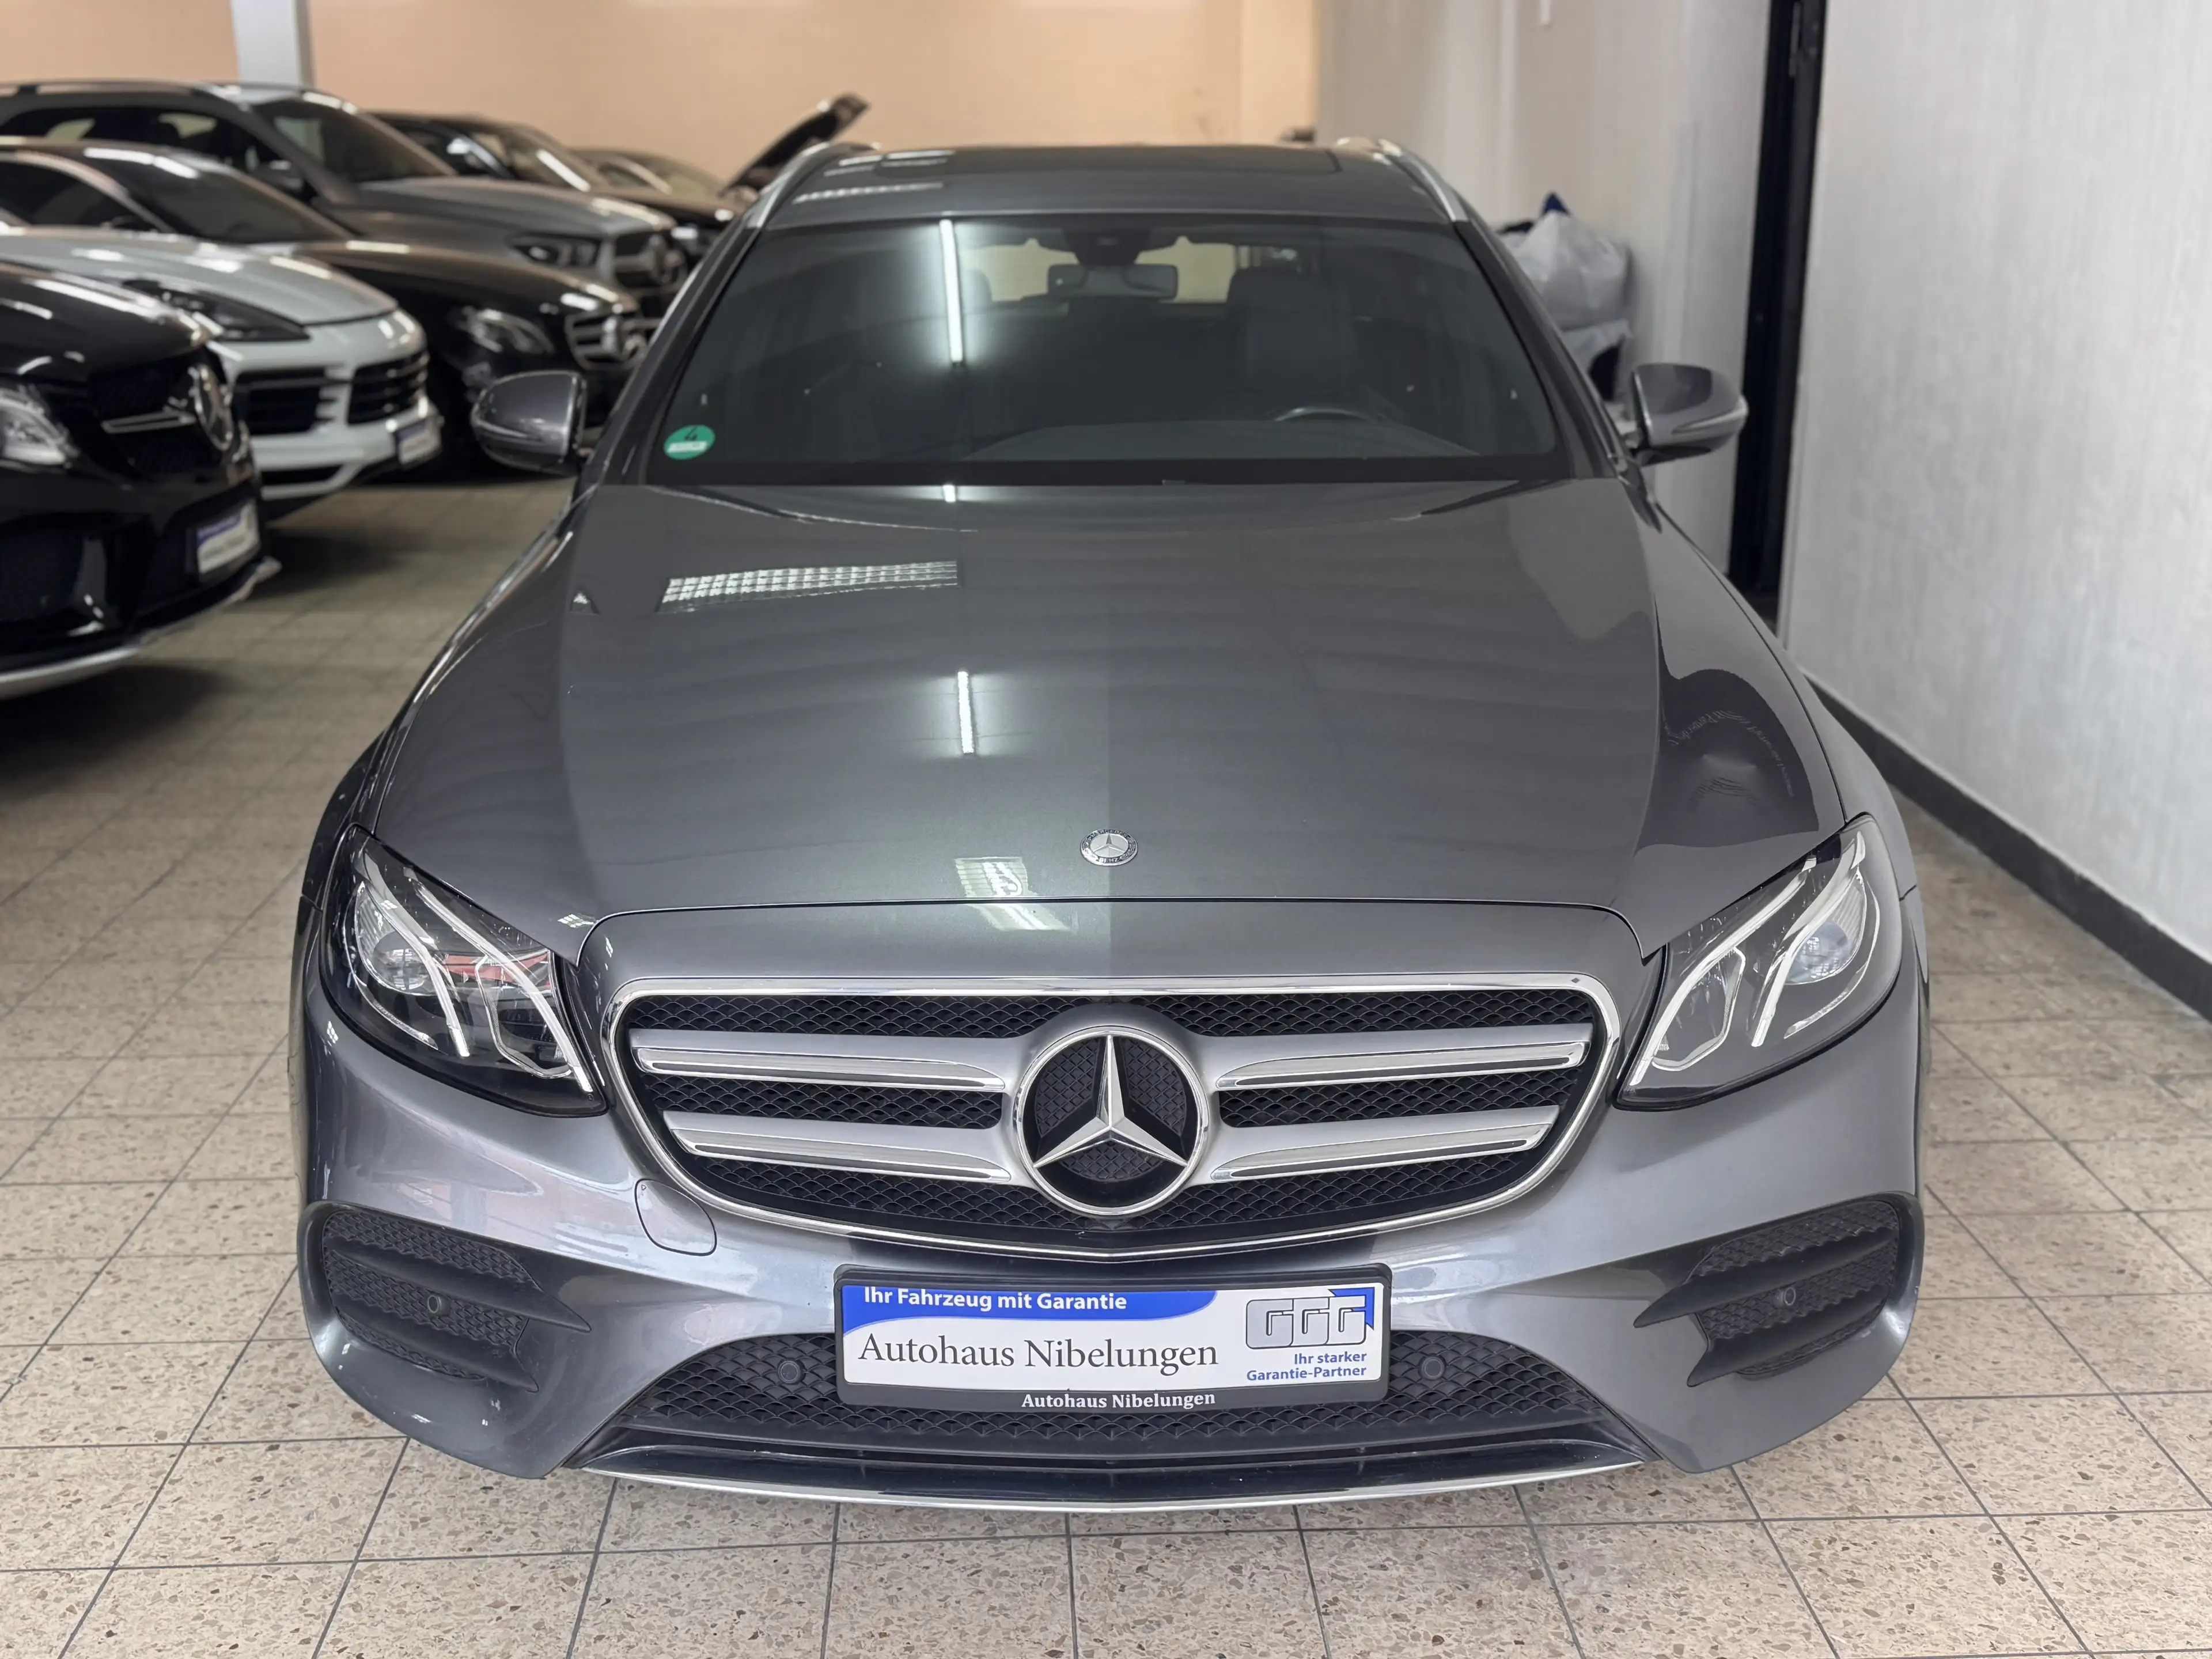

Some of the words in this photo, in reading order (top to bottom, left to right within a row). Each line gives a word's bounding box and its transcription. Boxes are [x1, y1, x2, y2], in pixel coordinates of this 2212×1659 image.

[865, 1286, 892, 1303] Ihr
[897, 1288, 992, 1312] Fahrzeug
[998, 1292, 1032, 1308] mit
[1037, 1293, 1127, 1309] Garantie
[1246, 1296, 1366, 1350] GGG
[858, 1333, 1014, 1366] Autohaus
[1024, 1338, 1219, 1376] Nibelungen
[1294, 1353, 1313, 1364] Ihr
[1317, 1351, 1367, 1363] starker
[1247, 1366, 1366, 1381] Garantie-Partner
[1021, 1393, 1107, 1408] Autohaus
[1112, 1393, 1215, 1410] Nibelungen
